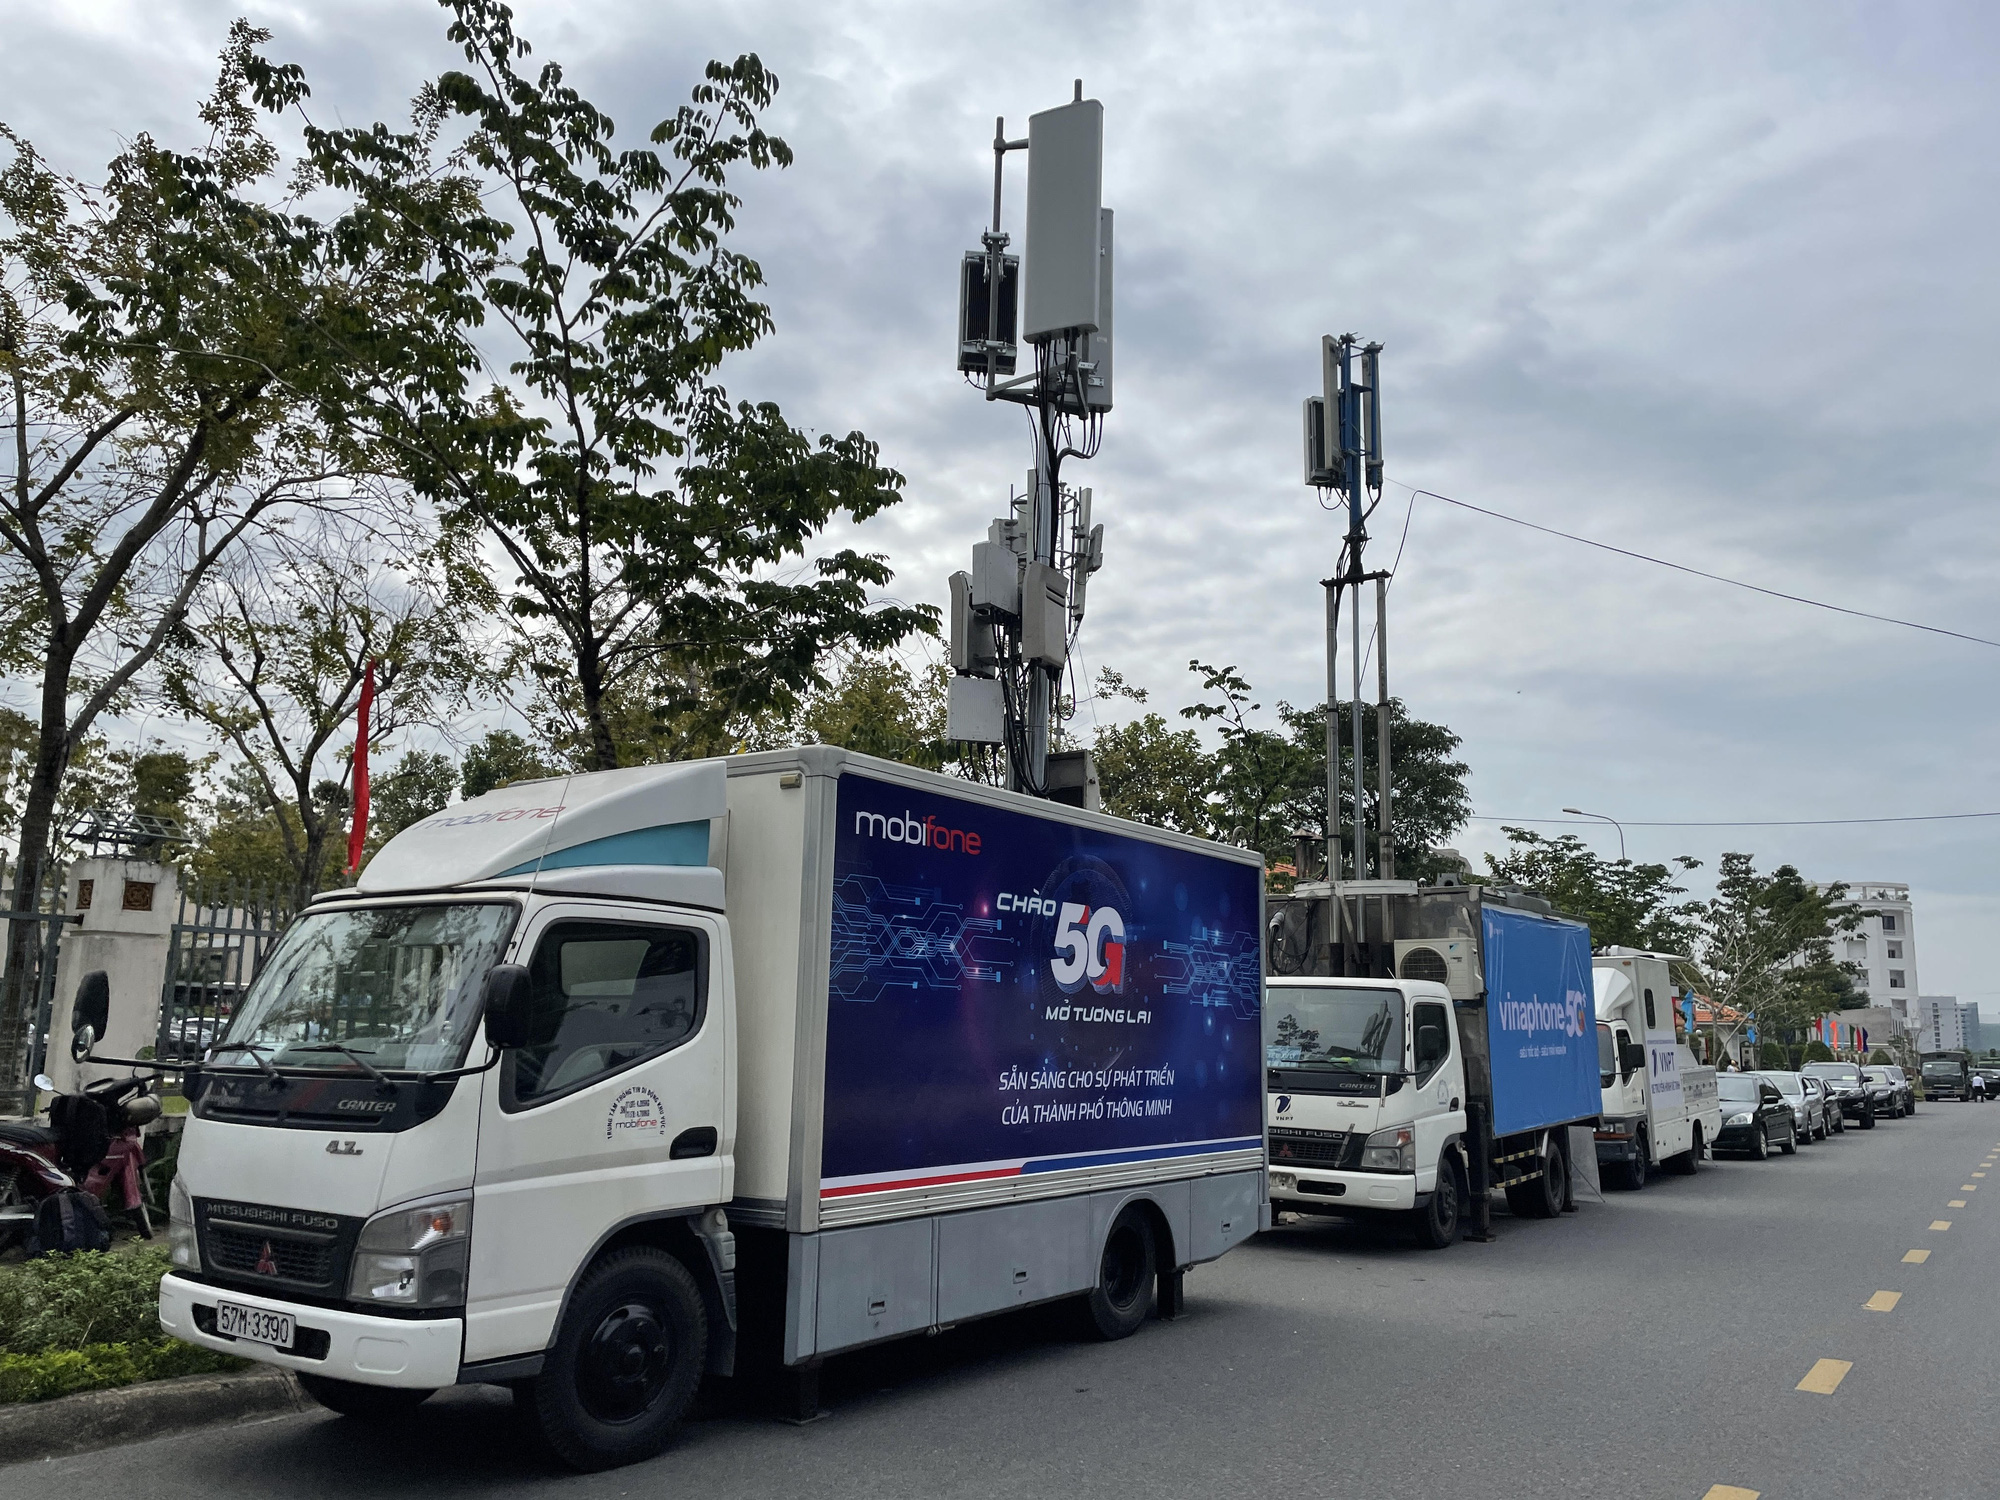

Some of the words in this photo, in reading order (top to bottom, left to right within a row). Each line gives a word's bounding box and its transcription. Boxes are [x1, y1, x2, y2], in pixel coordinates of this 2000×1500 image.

[412, 806, 566, 831] mobifone
[855, 809, 982, 855] mobifone
[996, 887, 1057, 917] CHÀO
[1050, 901, 1127, 995] 5G
[1045, 998, 1071, 1021] MỞ
[1073, 1005, 1124, 1023] TƯƠNG
[1126, 1009, 1152, 1024] LAI
[1499, 991, 1565, 1039] vinaphone
[998, 1064, 1029, 1091] SẴN
[1030, 1066, 1066, 1090] SÀNG
[1067, 1070, 1093, 1089] CHO
[1094, 1068, 1112, 1091] SỰ
[1112, 1065, 1143, 1087] PHÁT
[1144, 1062, 1175, 1086] TRIỂN
[1339, 1082, 1377, 1090] CANTER
[337, 1099, 397, 1113] CANTER
[1001, 1098, 1030, 1125] CỦA
[1033, 1100, 1077, 1123] THÀNH
[1078, 1096, 1104, 1120] PHỐ
[1105, 1096, 1144, 1119] THÔNG
[1144, 1098, 1173, 1116] MINH
[1305, 1130, 1343, 1139] FUSO
[206, 1203, 288, 1224] MITSUBISHI
[292, 1214, 339, 1230] FUSO
